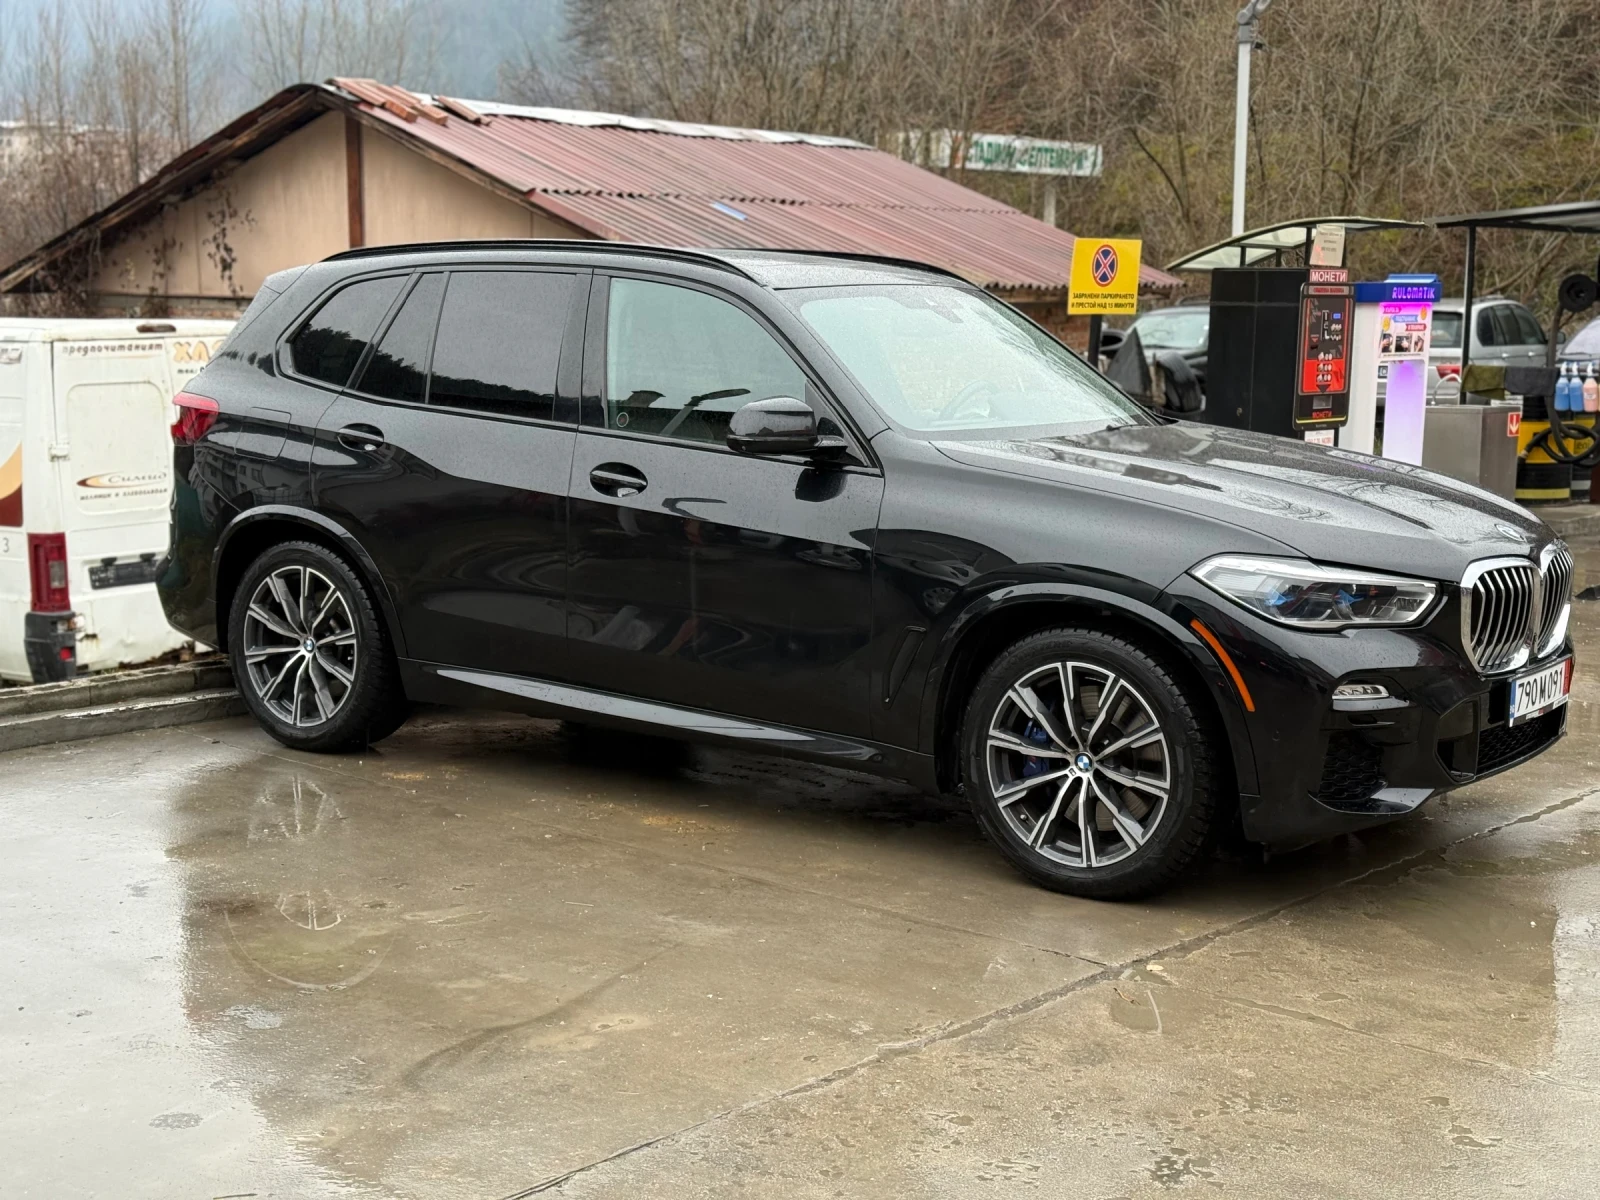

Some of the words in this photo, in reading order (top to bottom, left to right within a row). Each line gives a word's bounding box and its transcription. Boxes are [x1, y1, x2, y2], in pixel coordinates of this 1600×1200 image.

[1311, 271, 1346, 282] МОНЕТИ
[1392, 286, 1435, 299] RULOMATIK
[1075, 301, 1096, 309] ПРЕСТОЙ
[3, 536, 10, 553] 3
